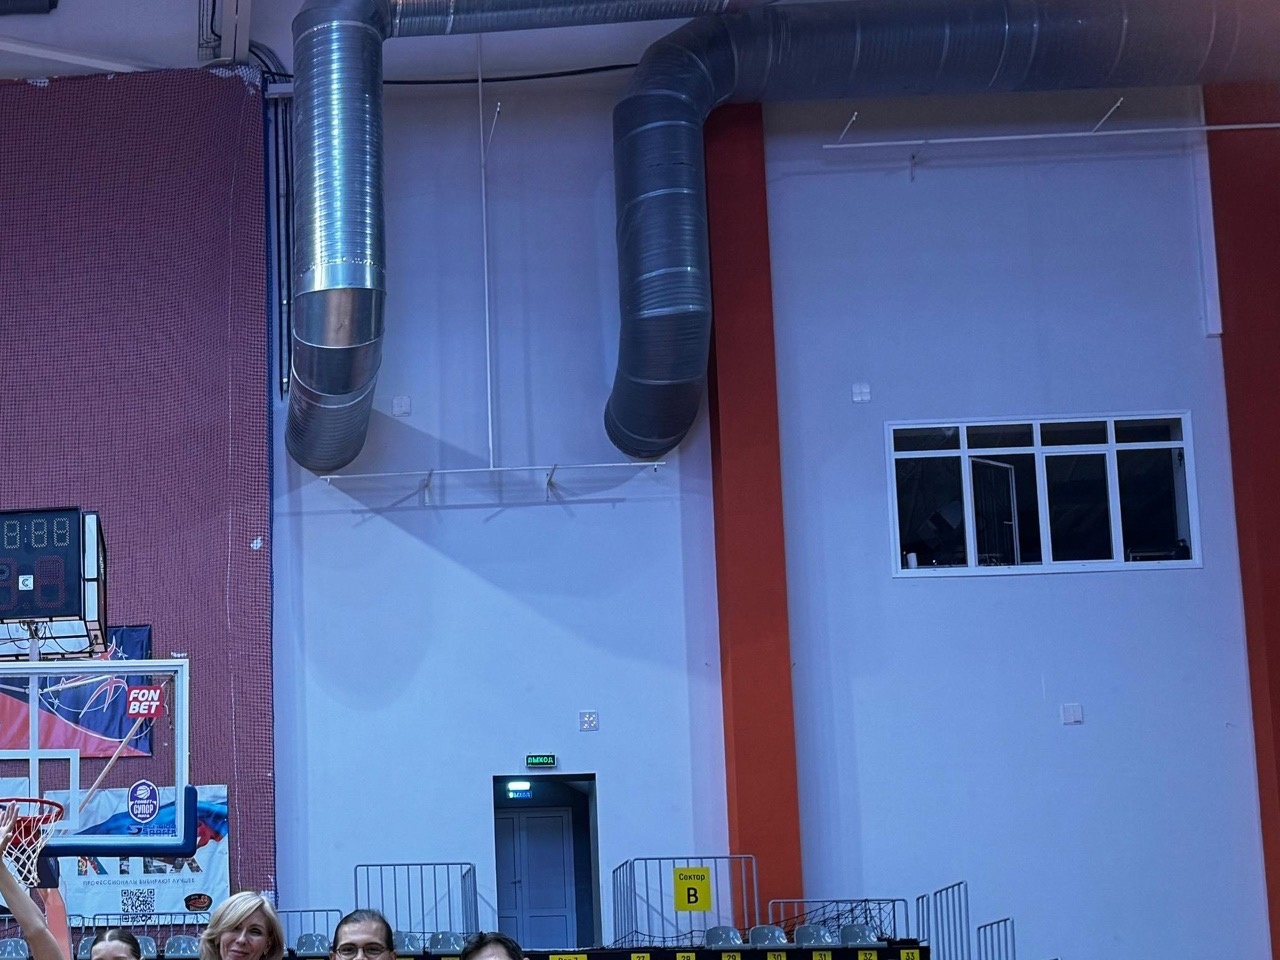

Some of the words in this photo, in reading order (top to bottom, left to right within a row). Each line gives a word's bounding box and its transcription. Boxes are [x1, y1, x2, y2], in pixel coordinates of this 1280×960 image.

[129, 689, 160, 701] FON
[128, 702, 160, 714] BET
[528, 756, 553, 764] ВЫХОД
[678, 872, 706, 882] Сектор
[905, 952, 916, 960] 33
